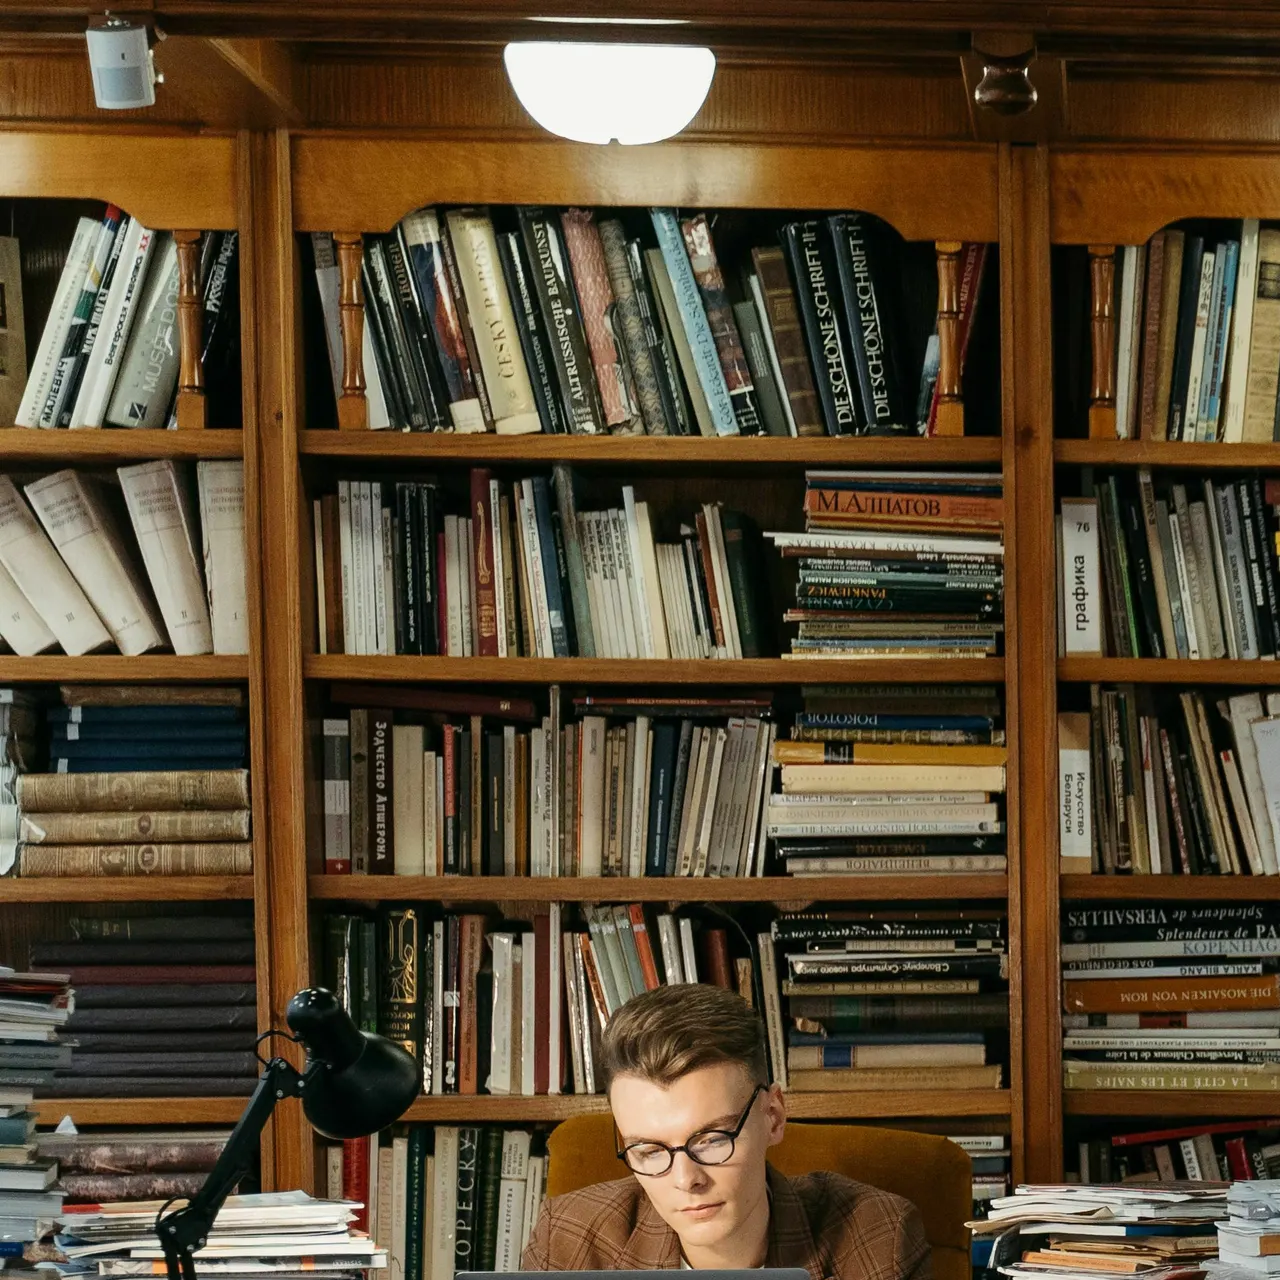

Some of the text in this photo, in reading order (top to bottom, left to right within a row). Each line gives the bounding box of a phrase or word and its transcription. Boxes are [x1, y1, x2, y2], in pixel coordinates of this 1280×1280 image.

[532, 222, 586, 401] ALTRUSSISCHE BAUKUNST
[104, 305, 129, 366] Венгерская
[490, 316, 516, 380] ČESKÝ
[860, 311, 885, 392] SCHÖNE
[817, 317, 851, 425] DIE SCHÖNE
[42, 360, 68, 424] МАЛЕВИЧ
[875, 392, 891, 419] DIE
[807, 585, 887, 599] PANKIEWICZ
[1072, 554, 1087, 632] графика
[806, 712, 878, 725] РОКОТОВ
[1063, 773, 1074, 834] Беларуси
[1074, 771, 1086, 836] Искусство
[845, 860, 930, 871] ВЕНЕЦИАНОВ
[1068, 906, 1264, 927] VERSAILLES de Splendeurs
[1156, 927, 1230, 942] Splendeurs
[1233, 927, 1249, 939] de
[820, 964, 849, 974] нового
[851, 963, 900, 974] Скульптура
[1068, 959, 1155, 971] DAS GEGENBILD
[1179, 966, 1257, 976] KARLA BILANG
[1120, 988, 1272, 1003] DIE MOSAIKEN VON ROM
[1105, 1050, 1244, 1061] Merveilleux Châteaux de la Loire
[1140, 1076, 1165, 1087] LES
[1170, 1076, 1188, 1087] ET
[1193, 1076, 1226, 1089] CITÉ
[1231, 1076, 1249, 1087] LA
[1182, 1143, 1201, 1179] KUNST
[455, 1127, 478, 1258] ОРЕСКУ
